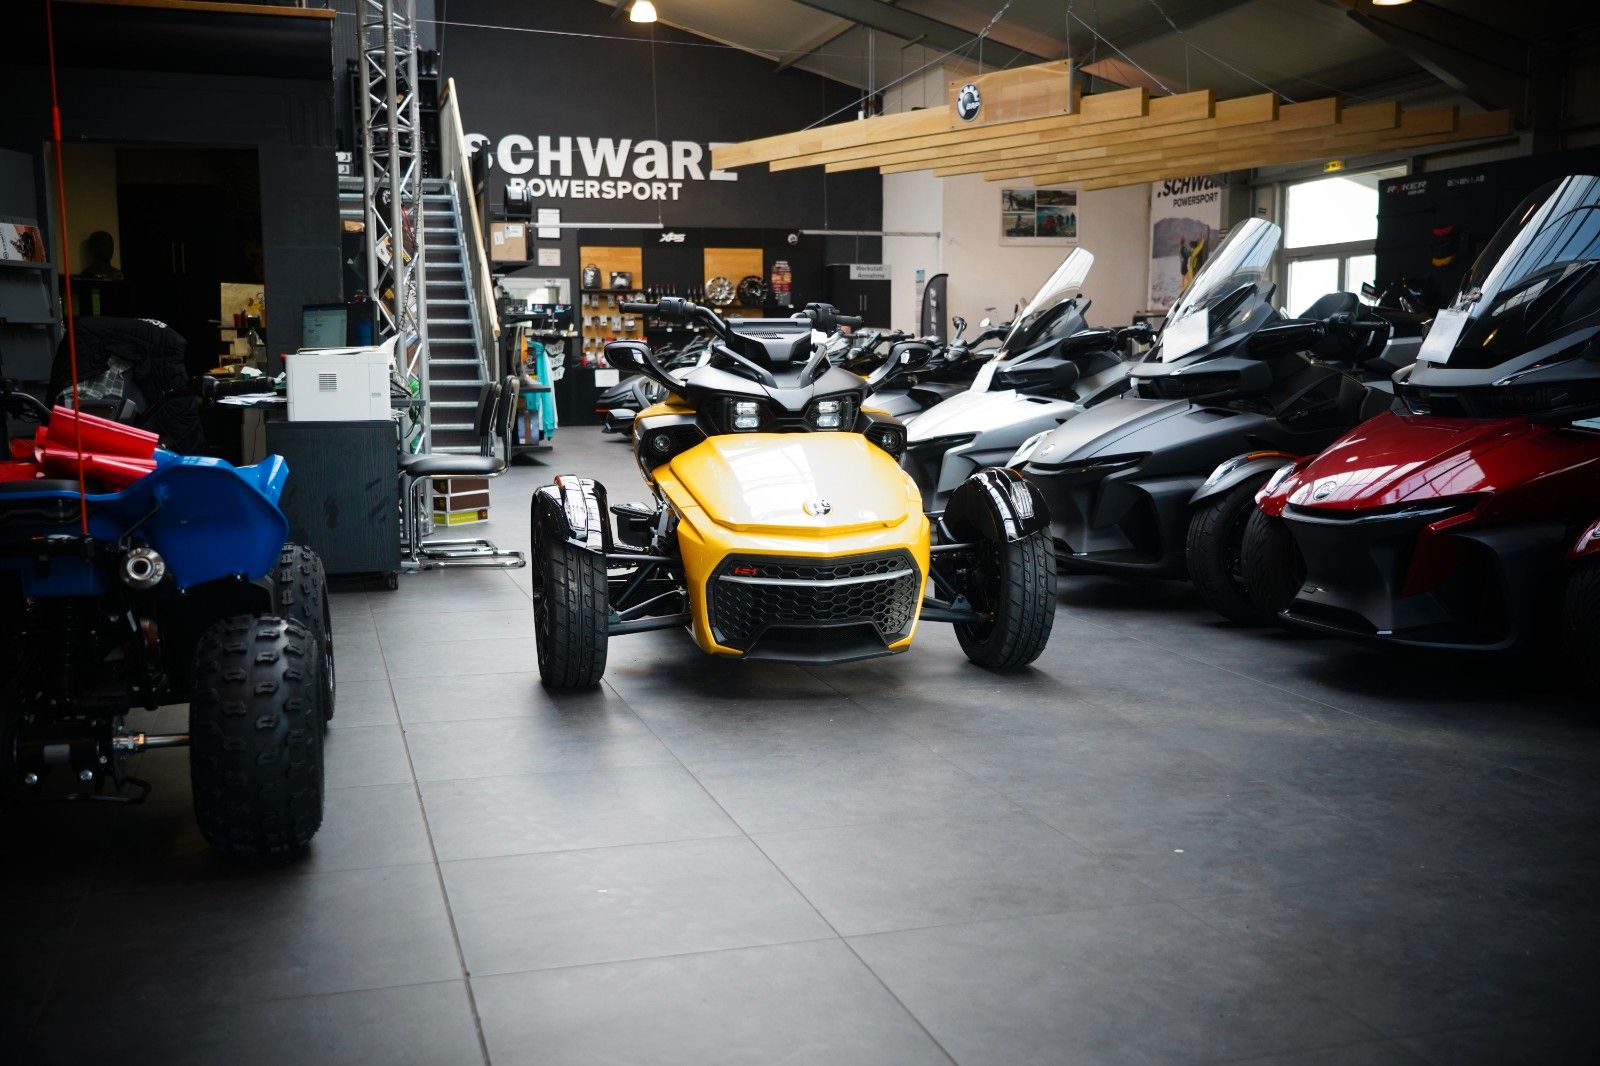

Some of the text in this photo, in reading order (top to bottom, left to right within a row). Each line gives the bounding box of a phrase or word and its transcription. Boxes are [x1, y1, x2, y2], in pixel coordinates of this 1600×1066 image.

[510, 177, 682, 201] POWERSPORT
[1157, 174, 1219, 198] .SCHWa
[1173, 192, 1218, 207] POWERSPORT
